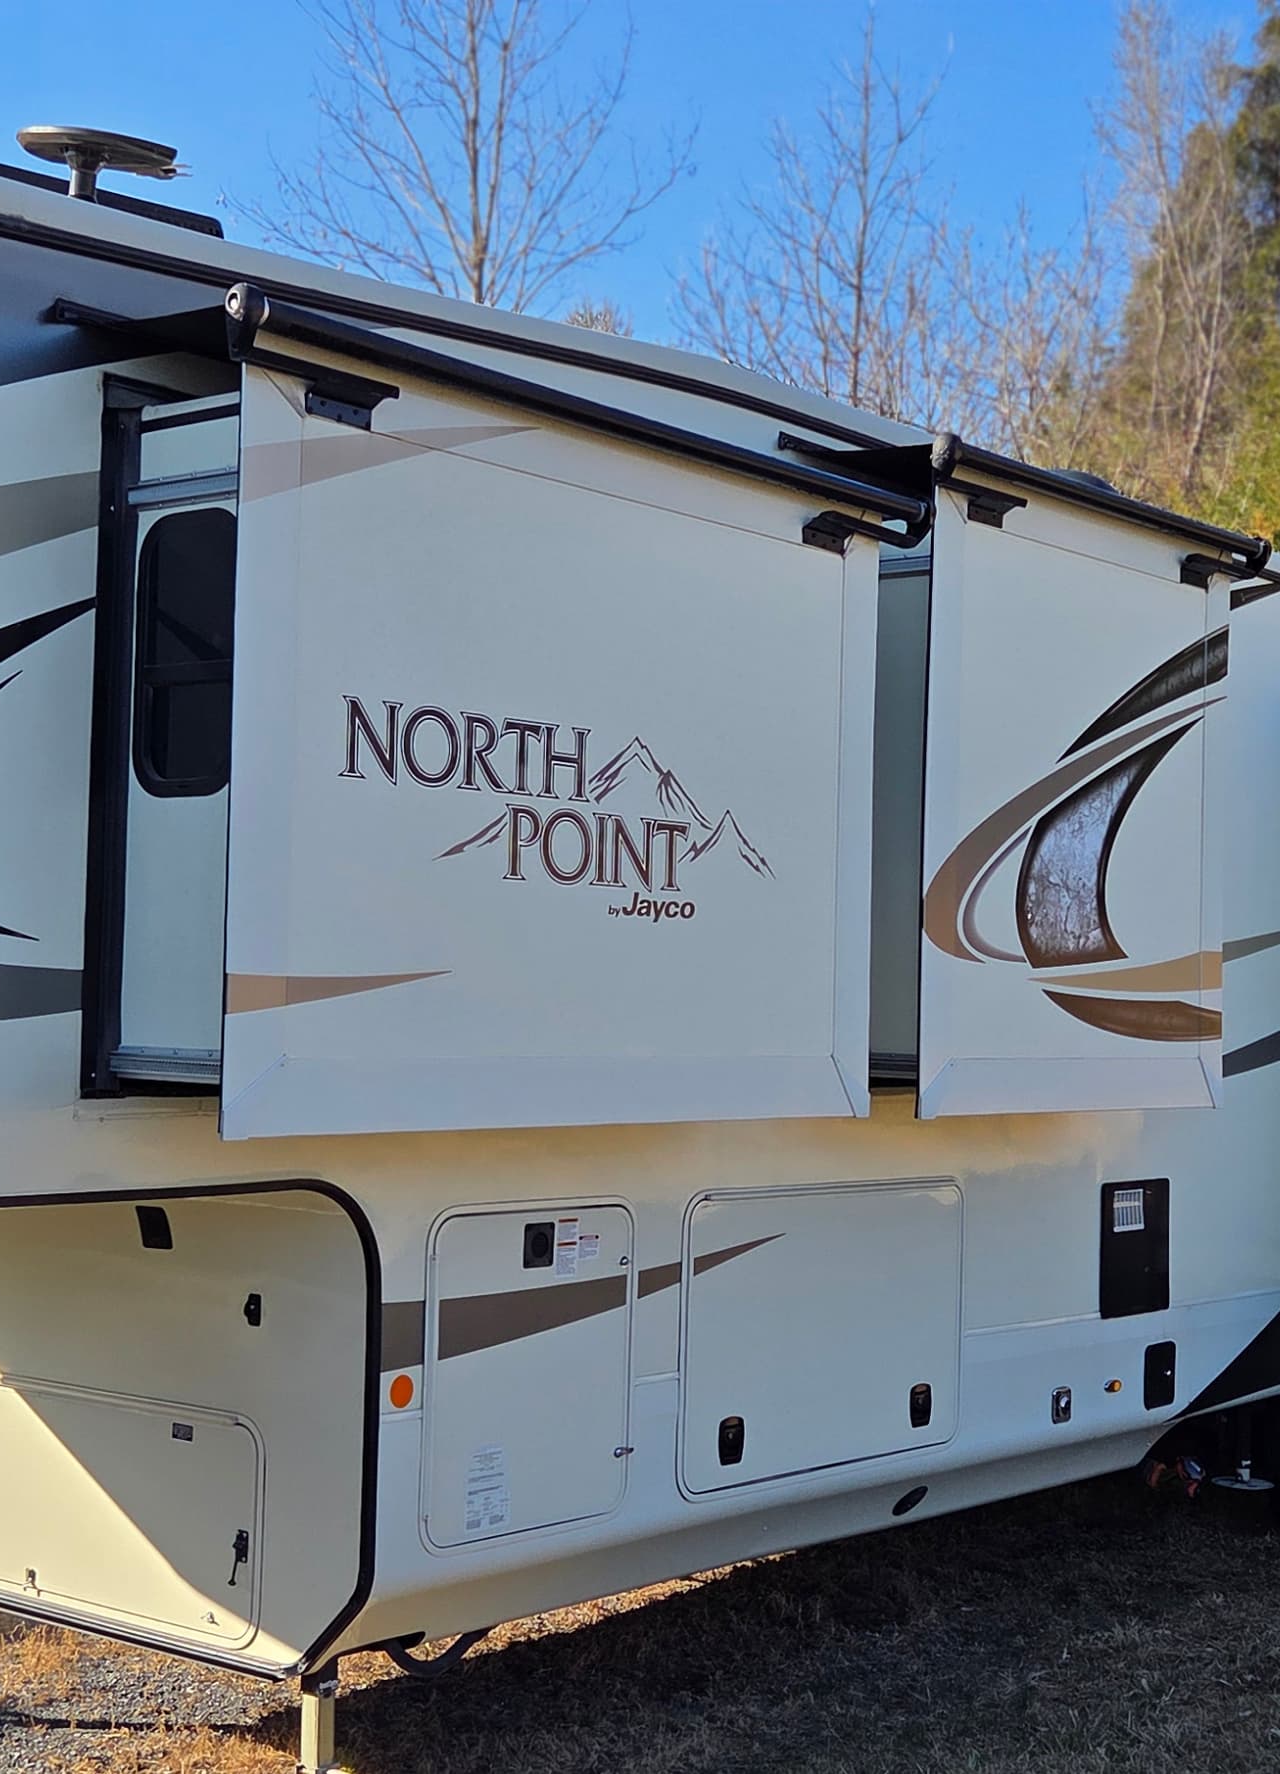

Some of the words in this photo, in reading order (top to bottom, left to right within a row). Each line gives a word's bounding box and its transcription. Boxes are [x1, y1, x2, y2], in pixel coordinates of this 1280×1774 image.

[338, 695, 591, 802] NORTH
[502, 803, 691, 892] POINT
[608, 904, 621, 918] by
[622, 891, 696, 923] Jayco
